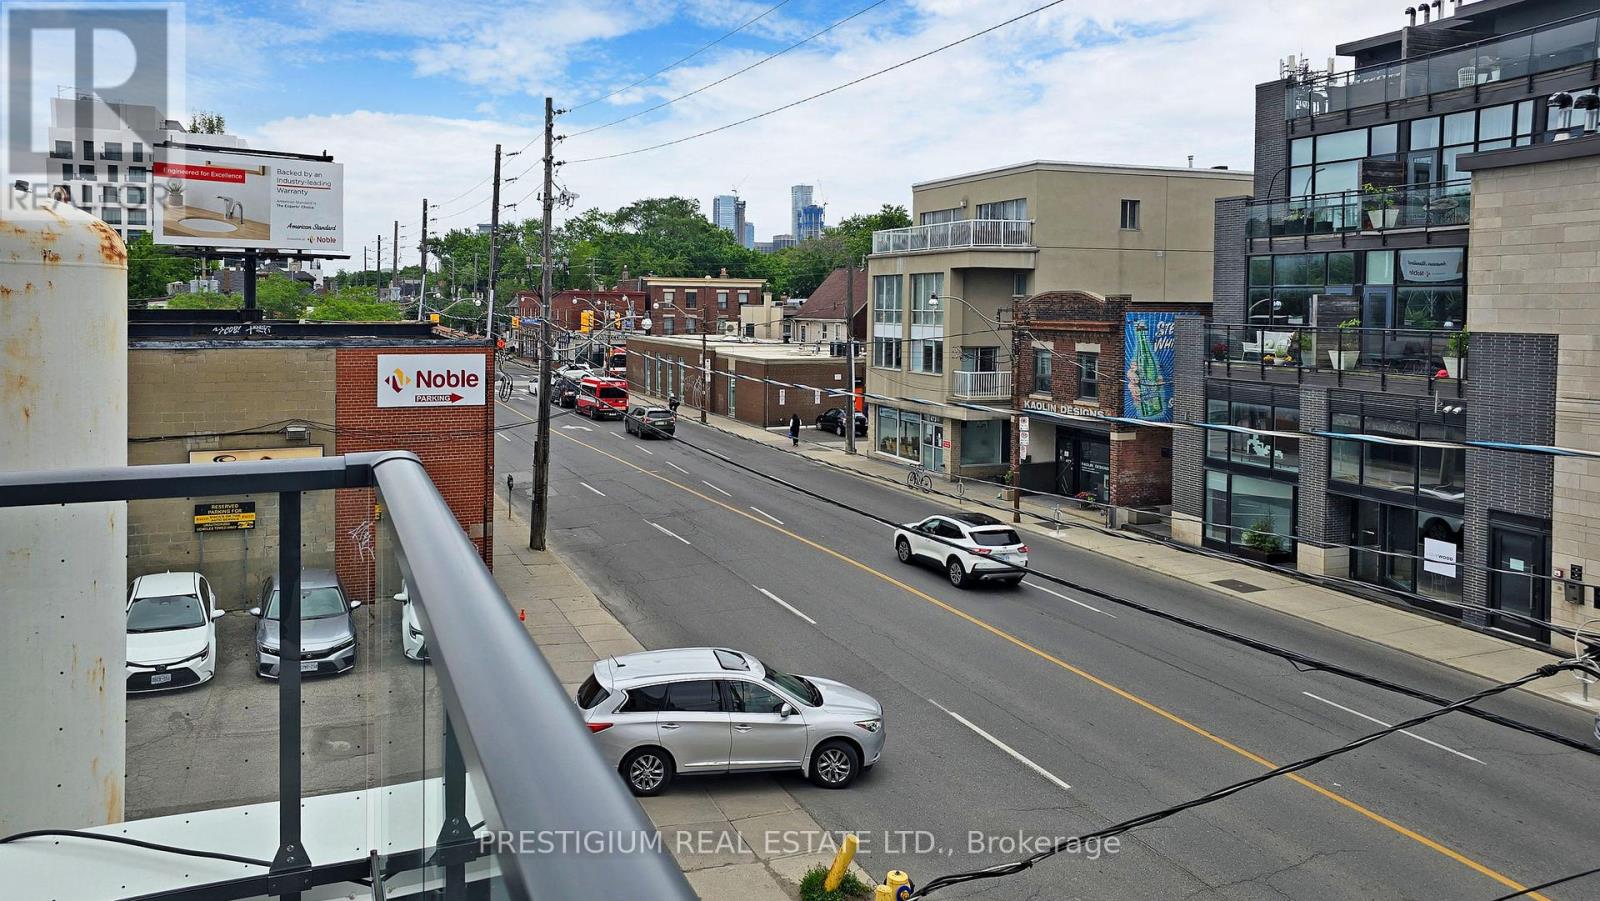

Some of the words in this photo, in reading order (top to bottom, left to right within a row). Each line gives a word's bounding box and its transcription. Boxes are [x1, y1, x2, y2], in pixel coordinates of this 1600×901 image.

[276, 168, 302, 177] Backed
[303, 170, 312, 178] by
[276, 178, 332, 187] Industry-leading
[276, 187, 308, 196] Warranty
[287, 222, 312, 230] American
[313, 223, 337, 231] Standard
[416, 369, 479, 388] Noble
[1024, 400, 1057, 412] KAOLIN
[1060, 405, 1105, 418] DESIGNS
